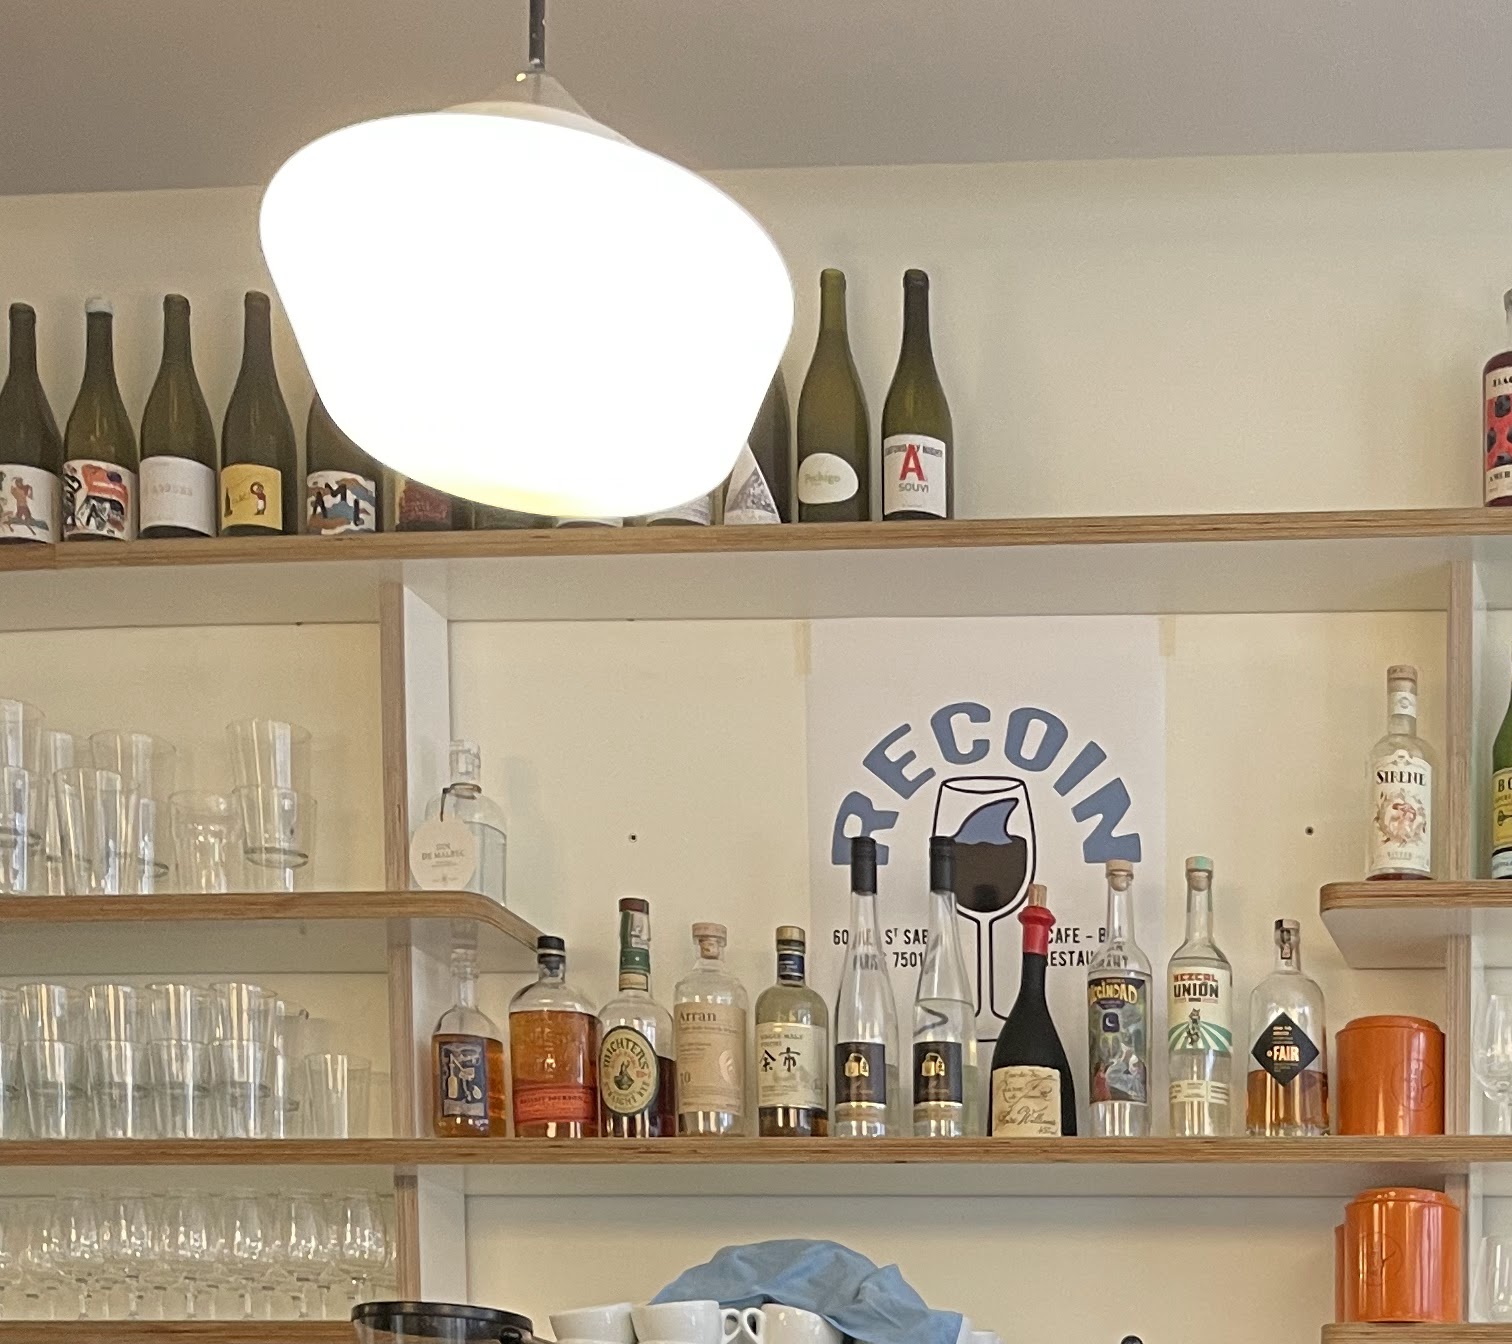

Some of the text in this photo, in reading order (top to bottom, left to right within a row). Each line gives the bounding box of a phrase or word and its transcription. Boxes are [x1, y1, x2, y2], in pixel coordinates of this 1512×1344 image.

[832, 701, 1142, 865] RECOIN
[833, 929, 849, 945] 60
[679, 1010, 717, 1022] Arran
[1273, 1045, 1300, 1062] FAIR
